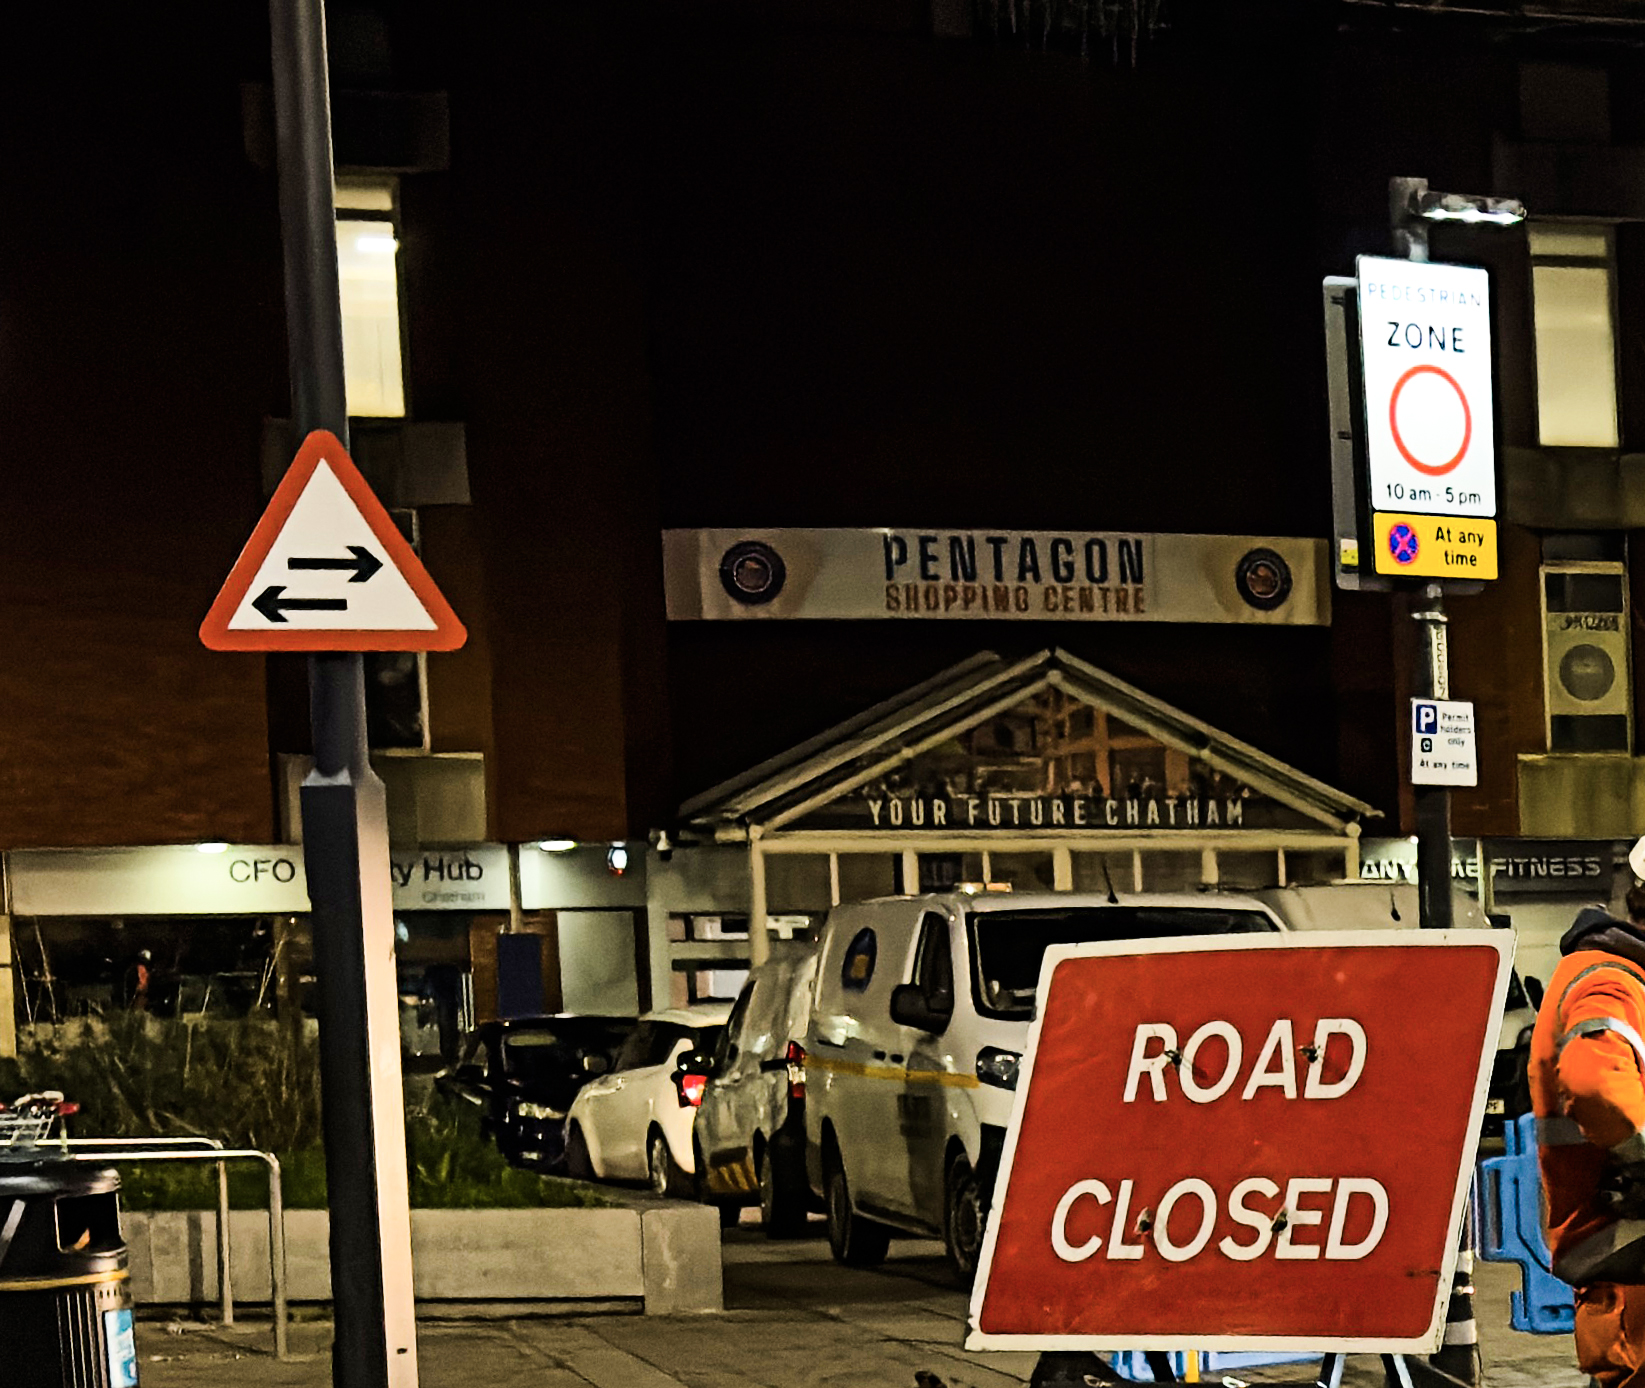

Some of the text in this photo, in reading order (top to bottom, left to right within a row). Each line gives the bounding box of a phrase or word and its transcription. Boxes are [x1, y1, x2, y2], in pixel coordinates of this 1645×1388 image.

[1368, 283, 1481, 307] PEDESTRIAN
[1387, 321, 1466, 353] ZONE
[1387, 483, 1404, 500] 10
[1409, 487, 1432, 502] am
[1446, 486, 1454, 503] 5
[1459, 491, 1481, 506] pm
[1436, 526, 1484, 547] At any
[883, 535, 1144, 585] PENTAGON
[1444, 550, 1477, 567] time
[885, 582, 1146, 613] SHOPPING CENTRE
[1420, 707, 1434, 732] P
[1442, 713, 1469, 721] Permit
[868, 799, 1243, 826] YOUR FUTURE CHATHAM
[229, 858, 296, 883] CFO
[423, 853, 484, 882] Hub
[1360, 857, 1601, 879] ANYME FITNESS
[1123, 1018, 1368, 1104] ROAD
[1051, 1177, 1390, 1263] CLOSED
